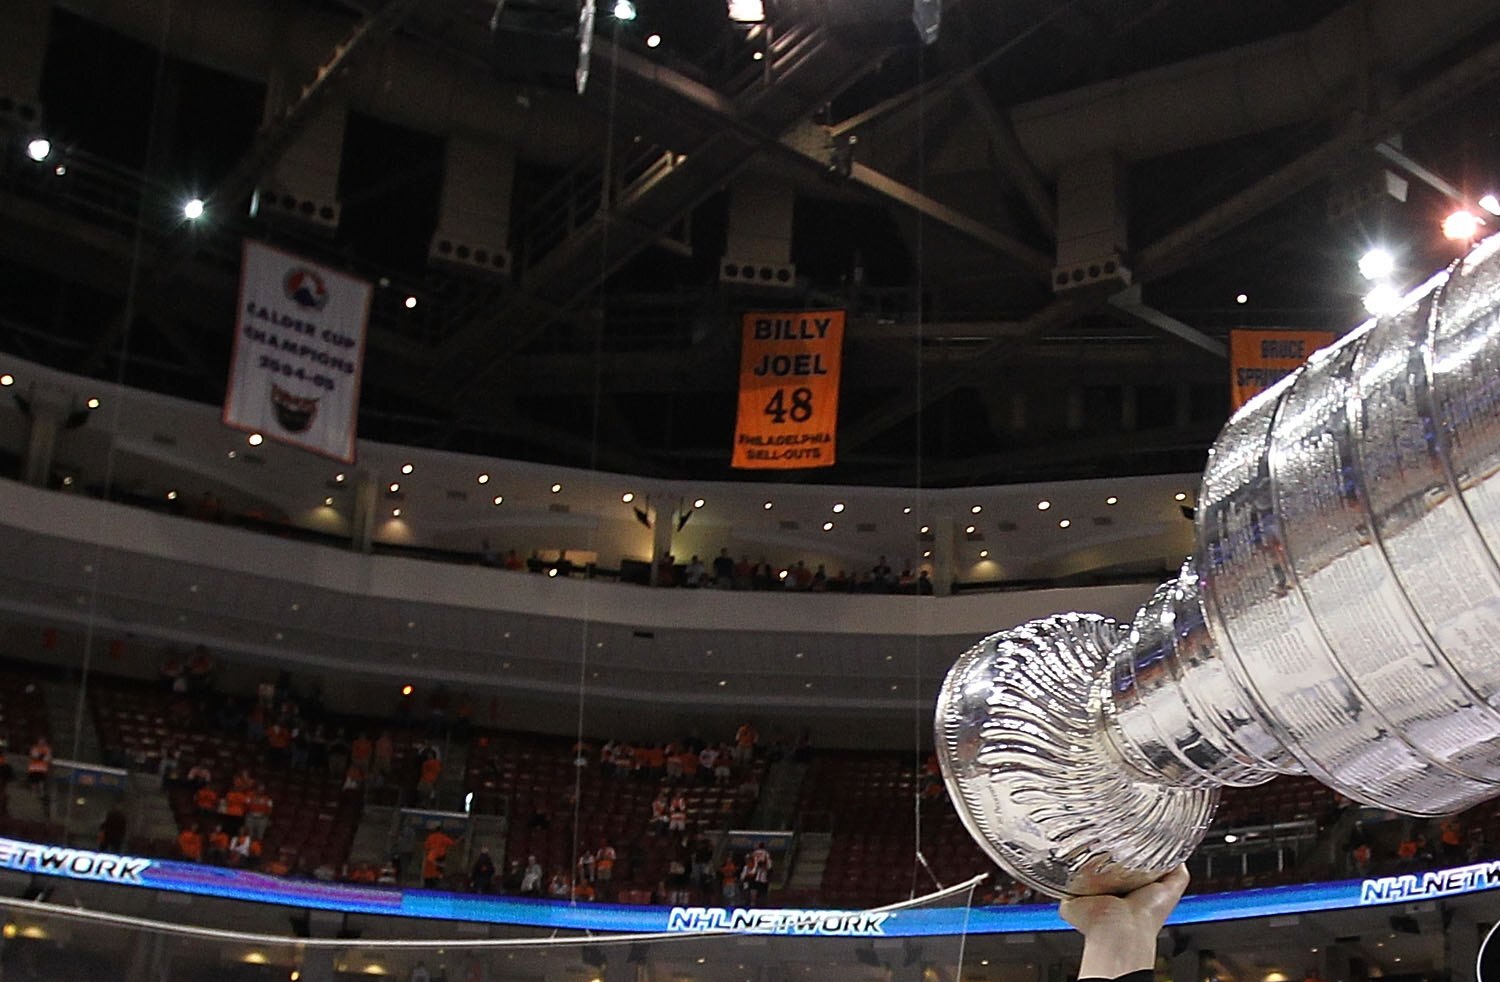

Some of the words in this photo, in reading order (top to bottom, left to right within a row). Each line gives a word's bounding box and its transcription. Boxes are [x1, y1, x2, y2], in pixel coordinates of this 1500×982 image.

[246, 302, 316, 337] CALDER
[321, 329, 355, 348] CUP
[754, 318, 831, 340] BILLY
[244, 326, 354, 374] CHAMPIONS
[754, 354, 828, 377] JOEL
[764, 387, 813, 424] 48
[739, 434, 831, 446] PHILADELPHIA
[746, 448, 821, 460] SELL-OUTS
